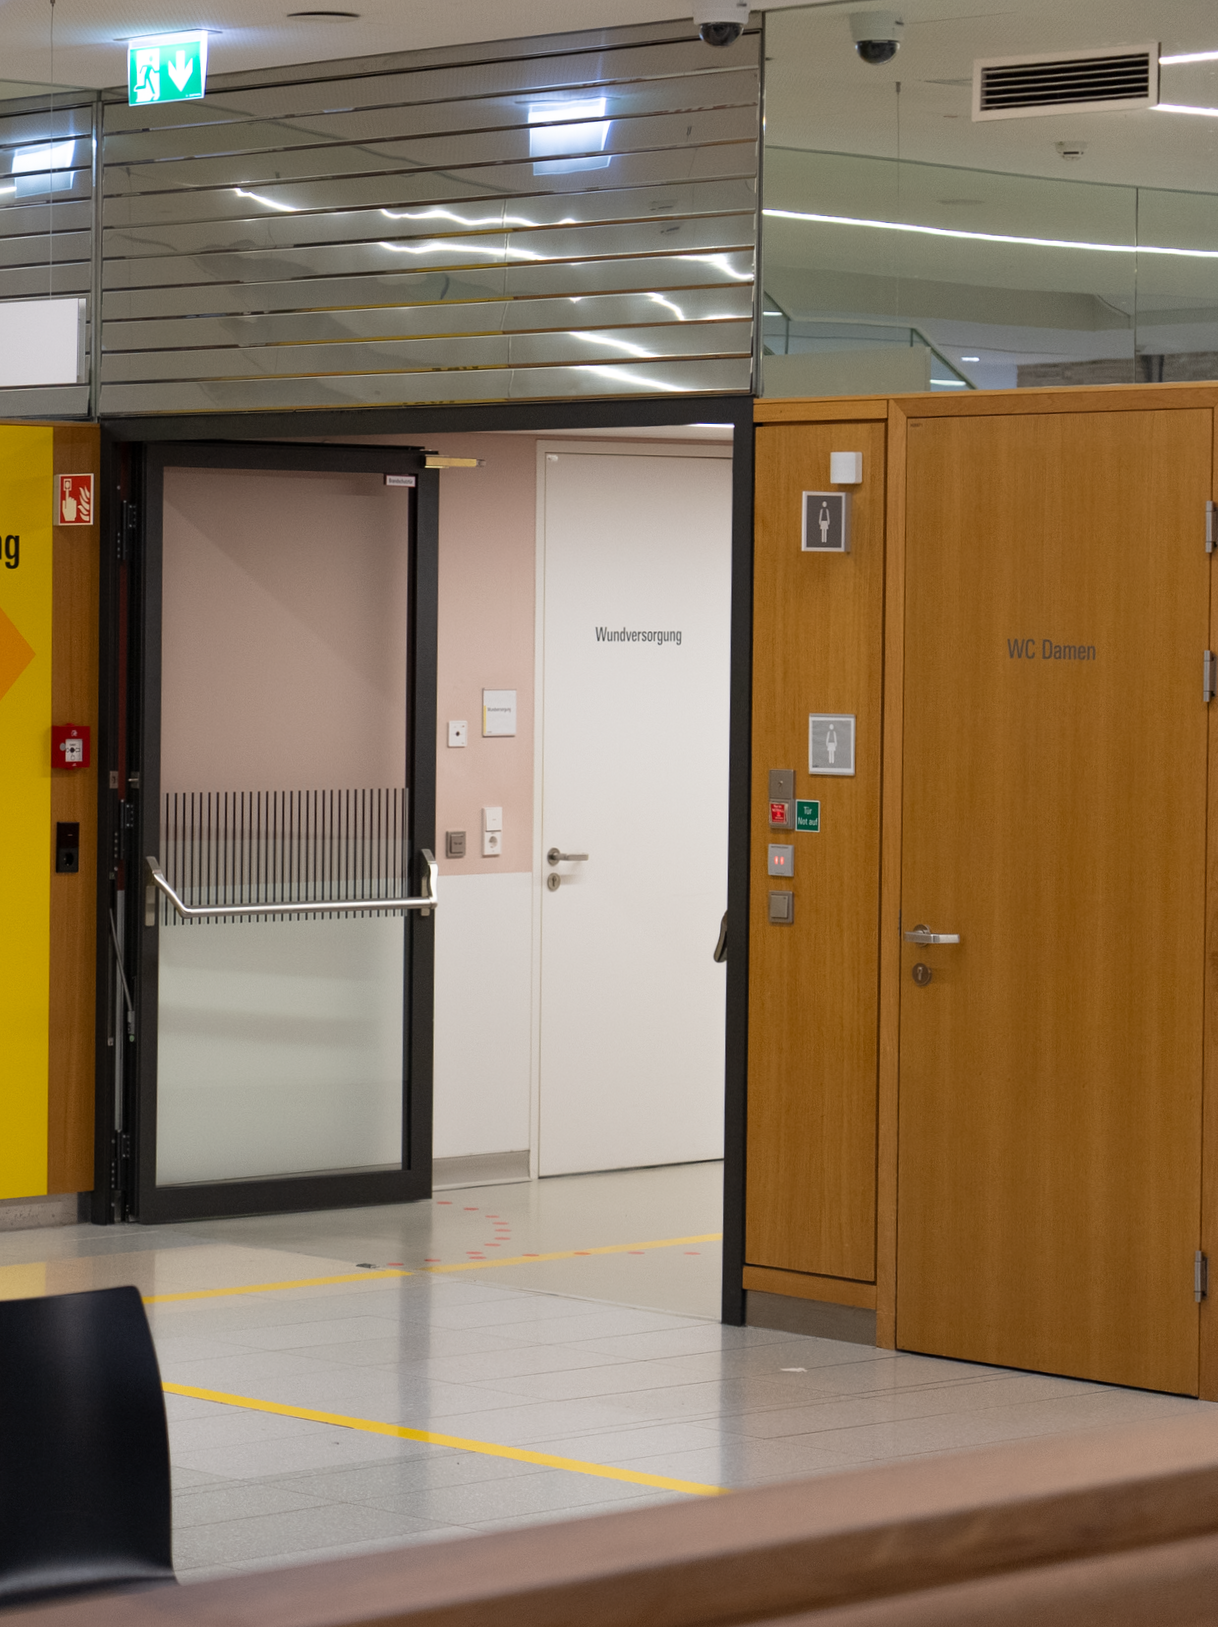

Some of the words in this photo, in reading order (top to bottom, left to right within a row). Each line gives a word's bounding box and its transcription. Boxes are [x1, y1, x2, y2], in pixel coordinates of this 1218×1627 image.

[595, 626, 682, 646] Wundversorgung
[1007, 638, 1036, 660] WC
[1041, 638, 1096, 661] Damen
[803, 806, 812, 815] Tür
[797, 816, 808, 826] Not
